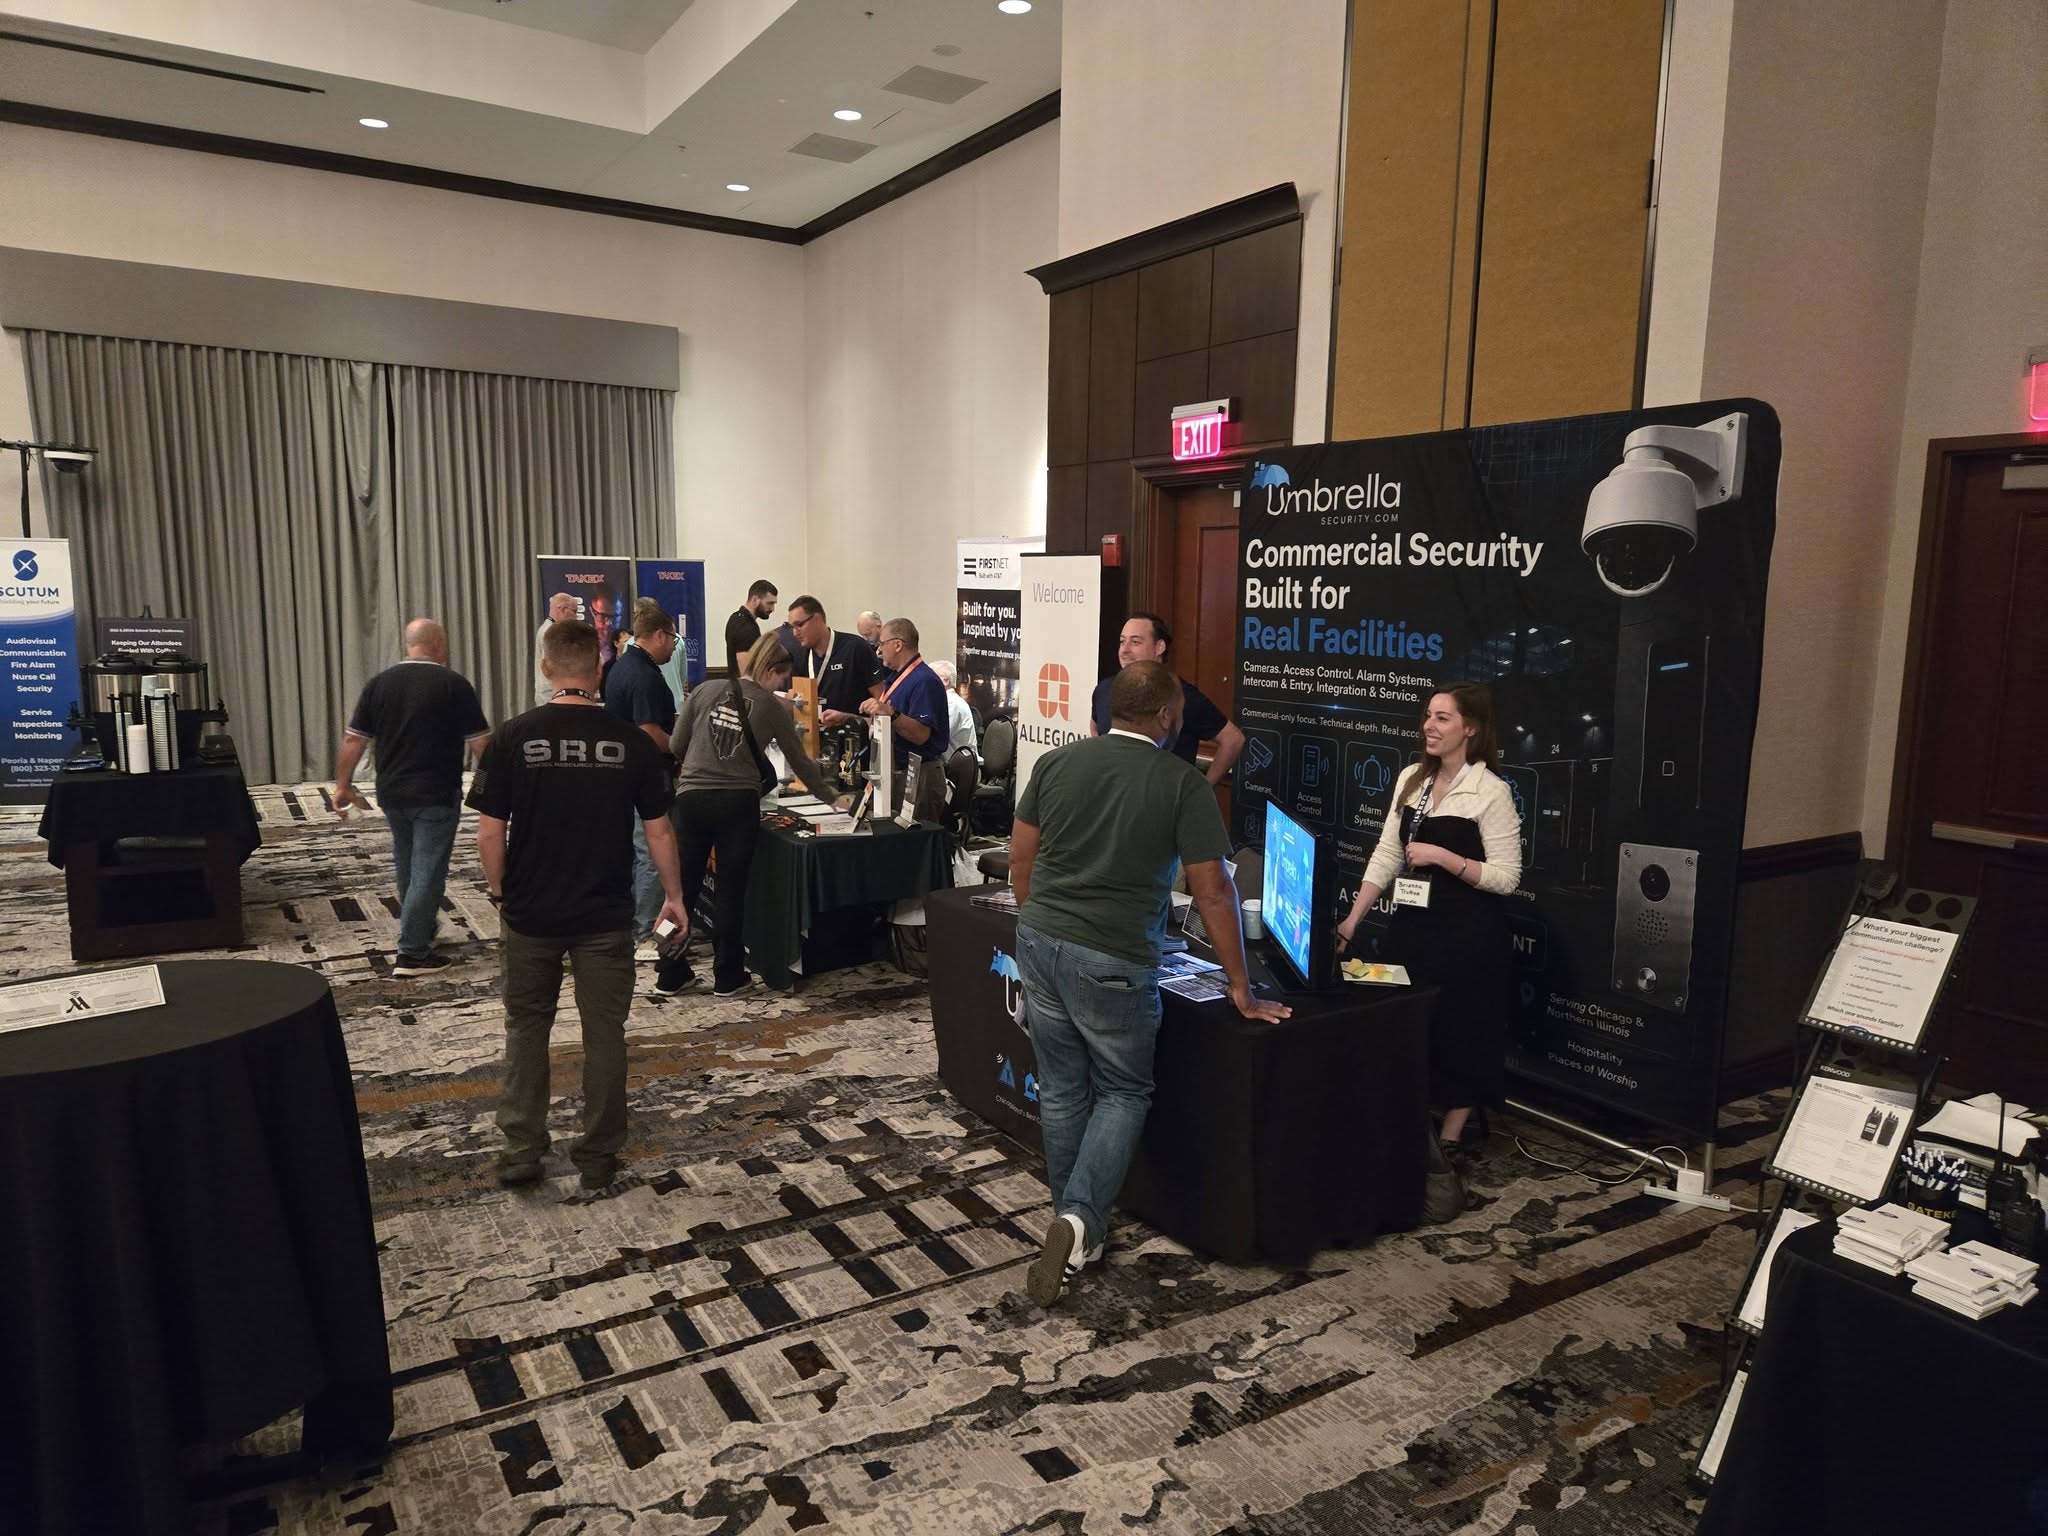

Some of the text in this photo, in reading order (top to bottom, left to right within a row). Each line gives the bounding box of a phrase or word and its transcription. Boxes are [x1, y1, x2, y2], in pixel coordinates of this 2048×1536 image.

[1181, 418, 1215, 457] EXIT
[1266, 473, 1401, 516] Umbrella
[1320, 513, 1400, 526] SECURITY.COM
[979, 558, 1009, 569] FIRSTNET
[1245, 531, 1544, 577] Commercial Security
[1032, 582, 1085, 604] Welcome
[1245, 575, 1351, 610] Built for
[962, 601, 1017, 622] Built for you.
[963, 620, 996, 639] Inspired
[997, 622, 1009, 642] by
[1244, 616, 1444, 662] Real Facilities
[11, 661, 56, 669] Fire Alarm
[1243, 661, 1436, 688] Cameras. Access Control. Alarm Systems.
[12, 673, 56, 681] Nurse Call
[17, 685, 53, 694] Security
[1242, 675, 1420, 703] Intercom & Entry. Integration & Service.
[20, 708, 53, 716] Service
[1241, 707, 1296, 724] Commercial-only
[1296, 713, 1318, 726] focus.
[1319, 716, 1354, 730] Technical
[1355, 721, 1380, 734] depth.
[1381, 724, 1400, 737] Real
[12, 721, 63, 729] Inspections
[1019, 723, 1087, 747] ALLEGION
[15, 733, 63, 741] Monitoring
[523, 739, 626, 763] SRO
[11, 765, 33, 773] (800)
[1244, 781, 1272, 795] Cameras
[1297, 792, 1322, 805] Access
[1296, 803, 1322, 817] Control
[1359, 803, 1382, 816] Alarm
[1354, 815, 1385, 829] Systems
[1337, 839, 1363, 853] Weapon
[1337, 850, 1366, 864] Detection
[1339, 888, 1349, 903] A
[1850, 930, 1945, 954] communication challenge?
[1863, 922, 1941, 944] What's your biggest
[1550, 992, 1645, 1028] Serving Chicago &
[1827, 1005, 1844, 1014] Which
[1856, 1012, 1877, 1023] sounds
[1877, 1018, 1904, 1029] familiar?
[1547, 1006, 1630, 1038] Northern Illinois
[1567, 1040, 1623, 1066] Hospitality
[1547, 1052, 1638, 1090] Places of Worship
[1820, 1065, 1851, 1078] KENWOOD
